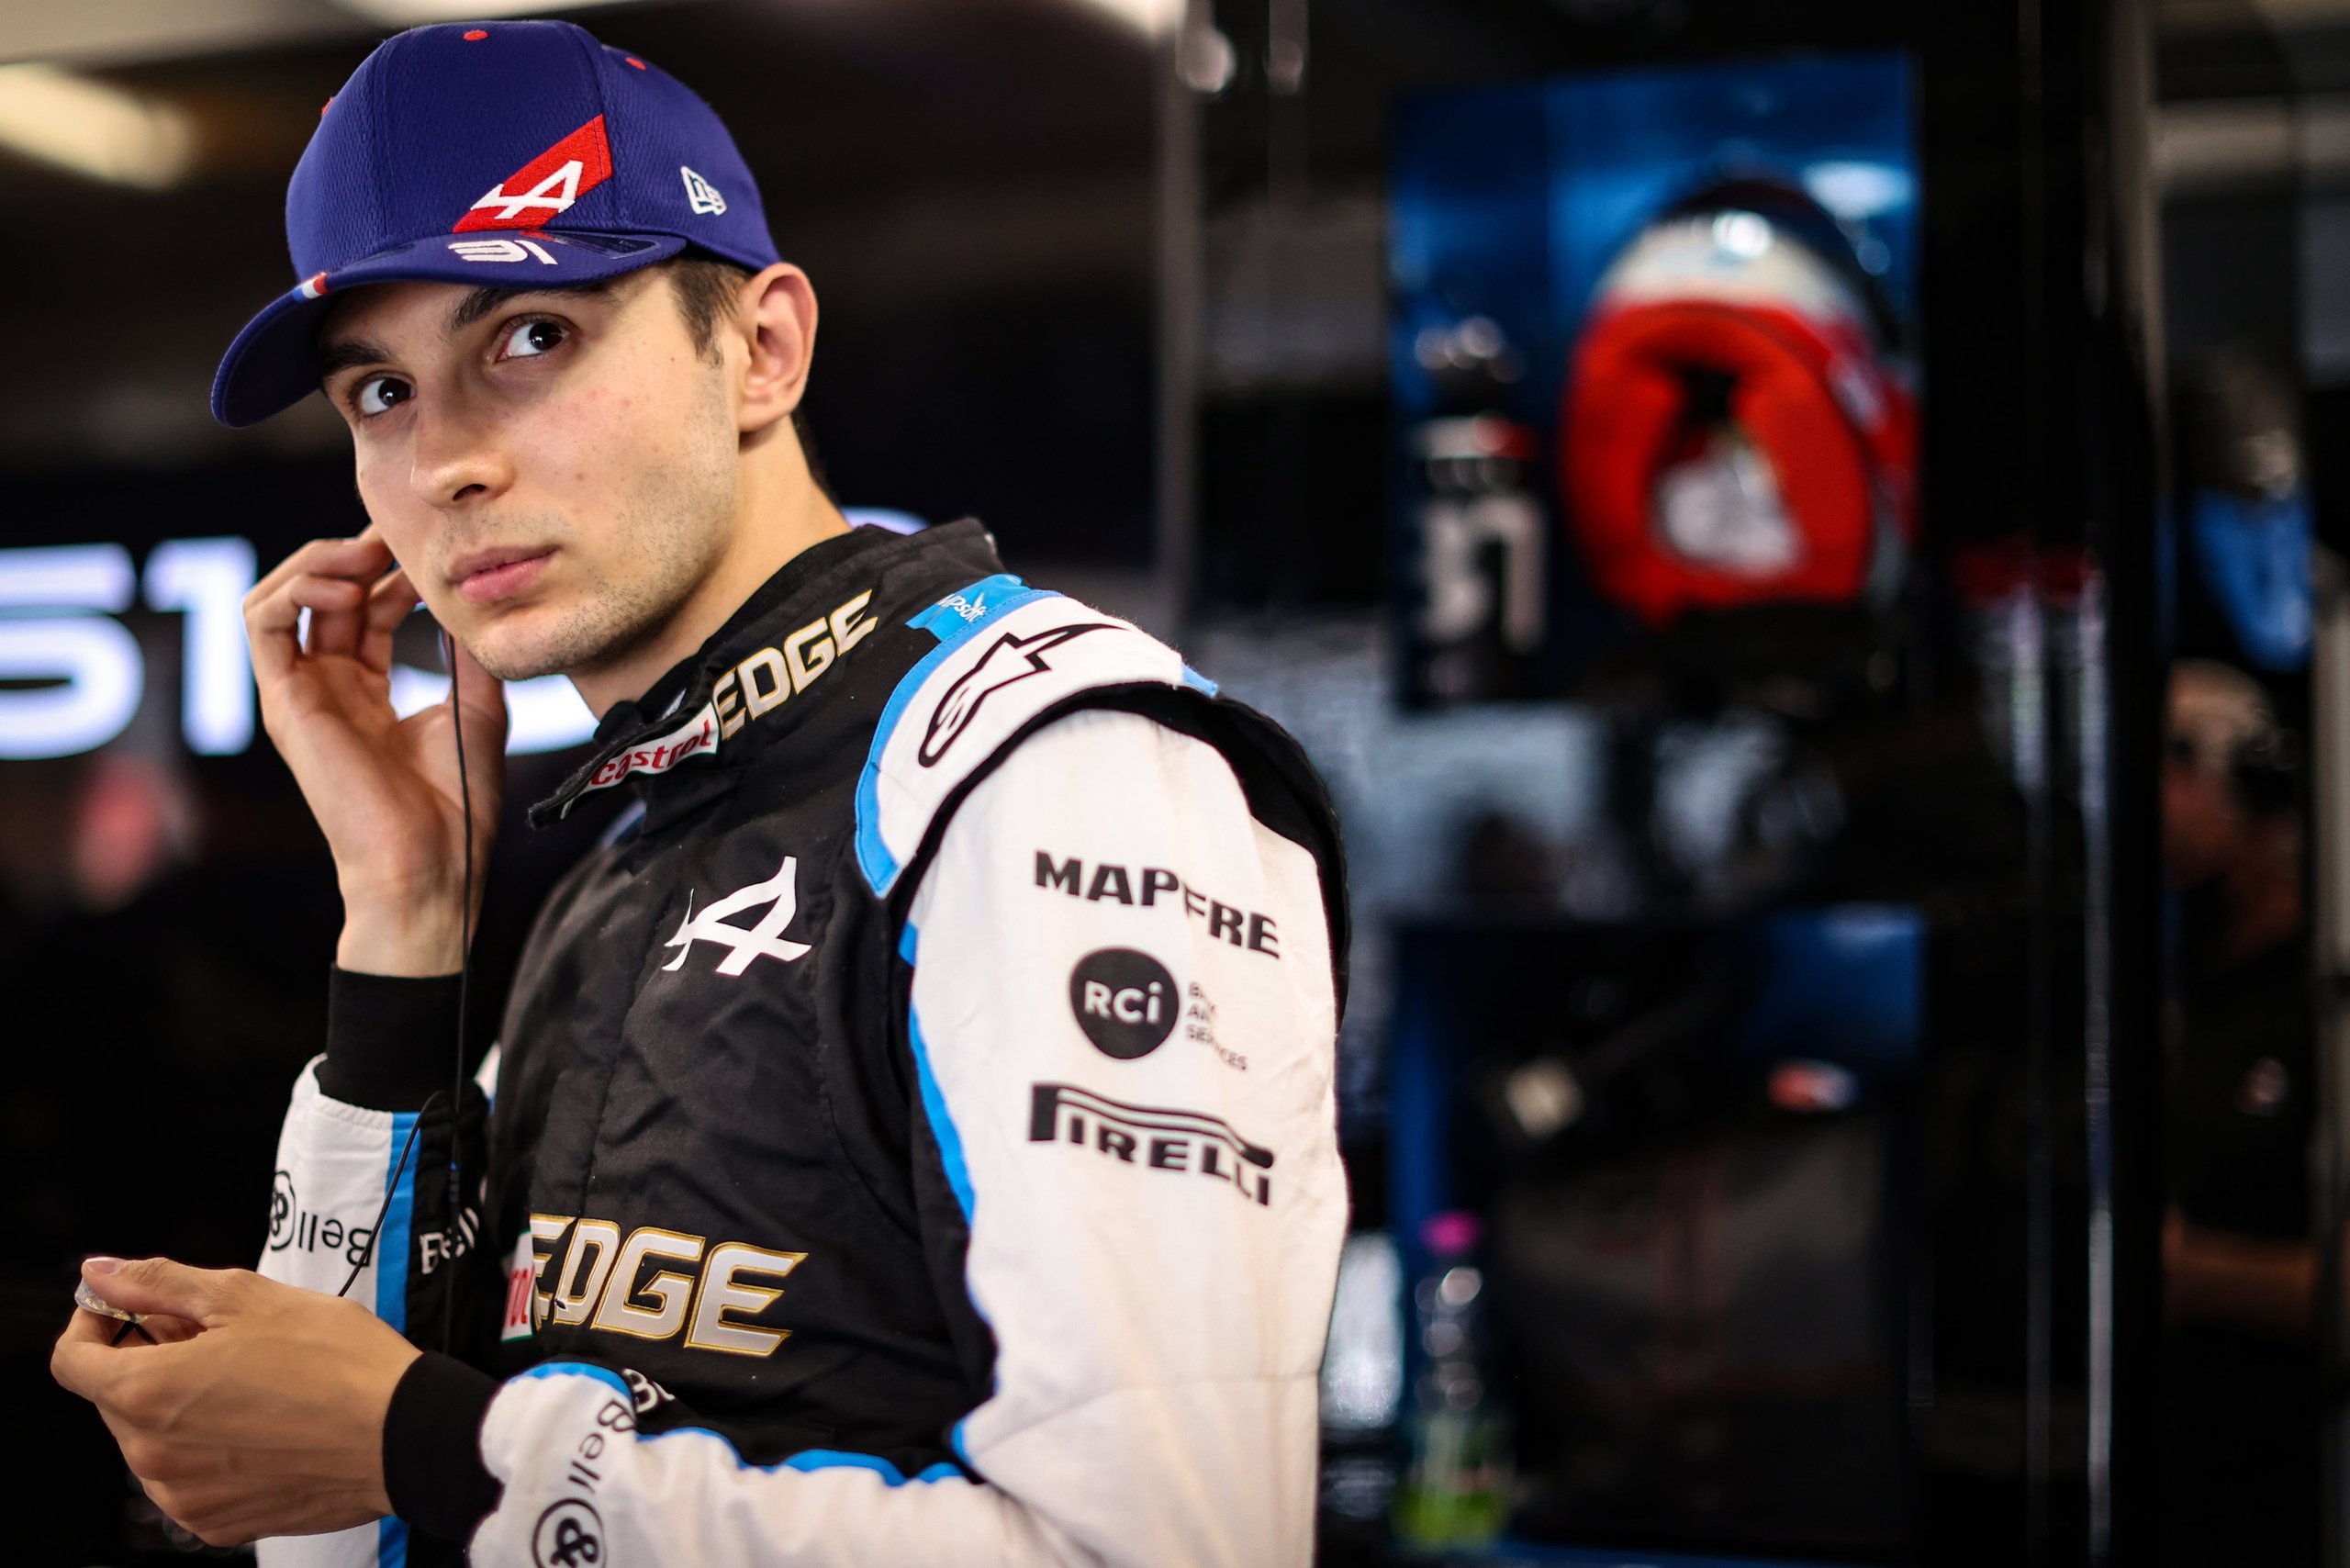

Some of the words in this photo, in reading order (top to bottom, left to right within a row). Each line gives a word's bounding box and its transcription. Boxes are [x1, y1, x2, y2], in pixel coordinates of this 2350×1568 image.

[712, 589, 878, 742] EDGE
[1034, 850, 1281, 960] MAPFRE
[1027, 1082, 1275, 1207] PIRELLI
[298, 1211, 374, 1268] Bell
[529, 1212, 810, 1358] EDGE
[567, 1398, 637, 1495] Bell
